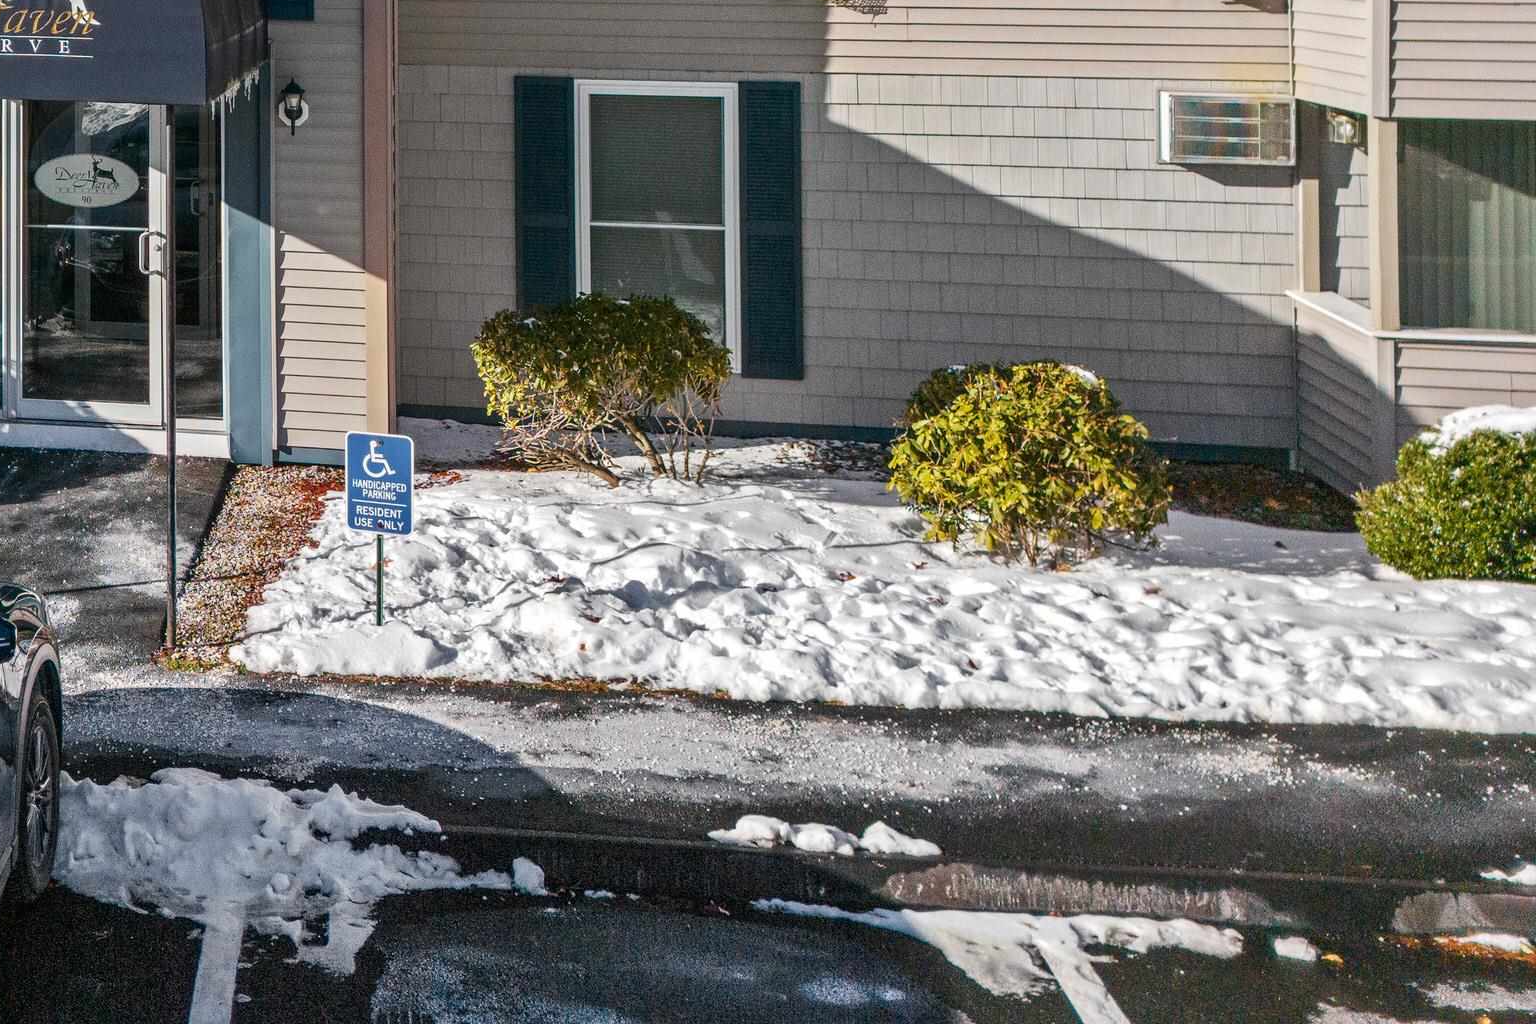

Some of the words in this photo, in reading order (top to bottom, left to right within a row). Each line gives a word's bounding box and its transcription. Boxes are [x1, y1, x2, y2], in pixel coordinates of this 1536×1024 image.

[352, 479, 407, 493] HANDICAPPED
[362, 489, 396, 501] PARKING
[356, 505, 402, 519] RESIDENT
[354, 517, 373, 528] USE
